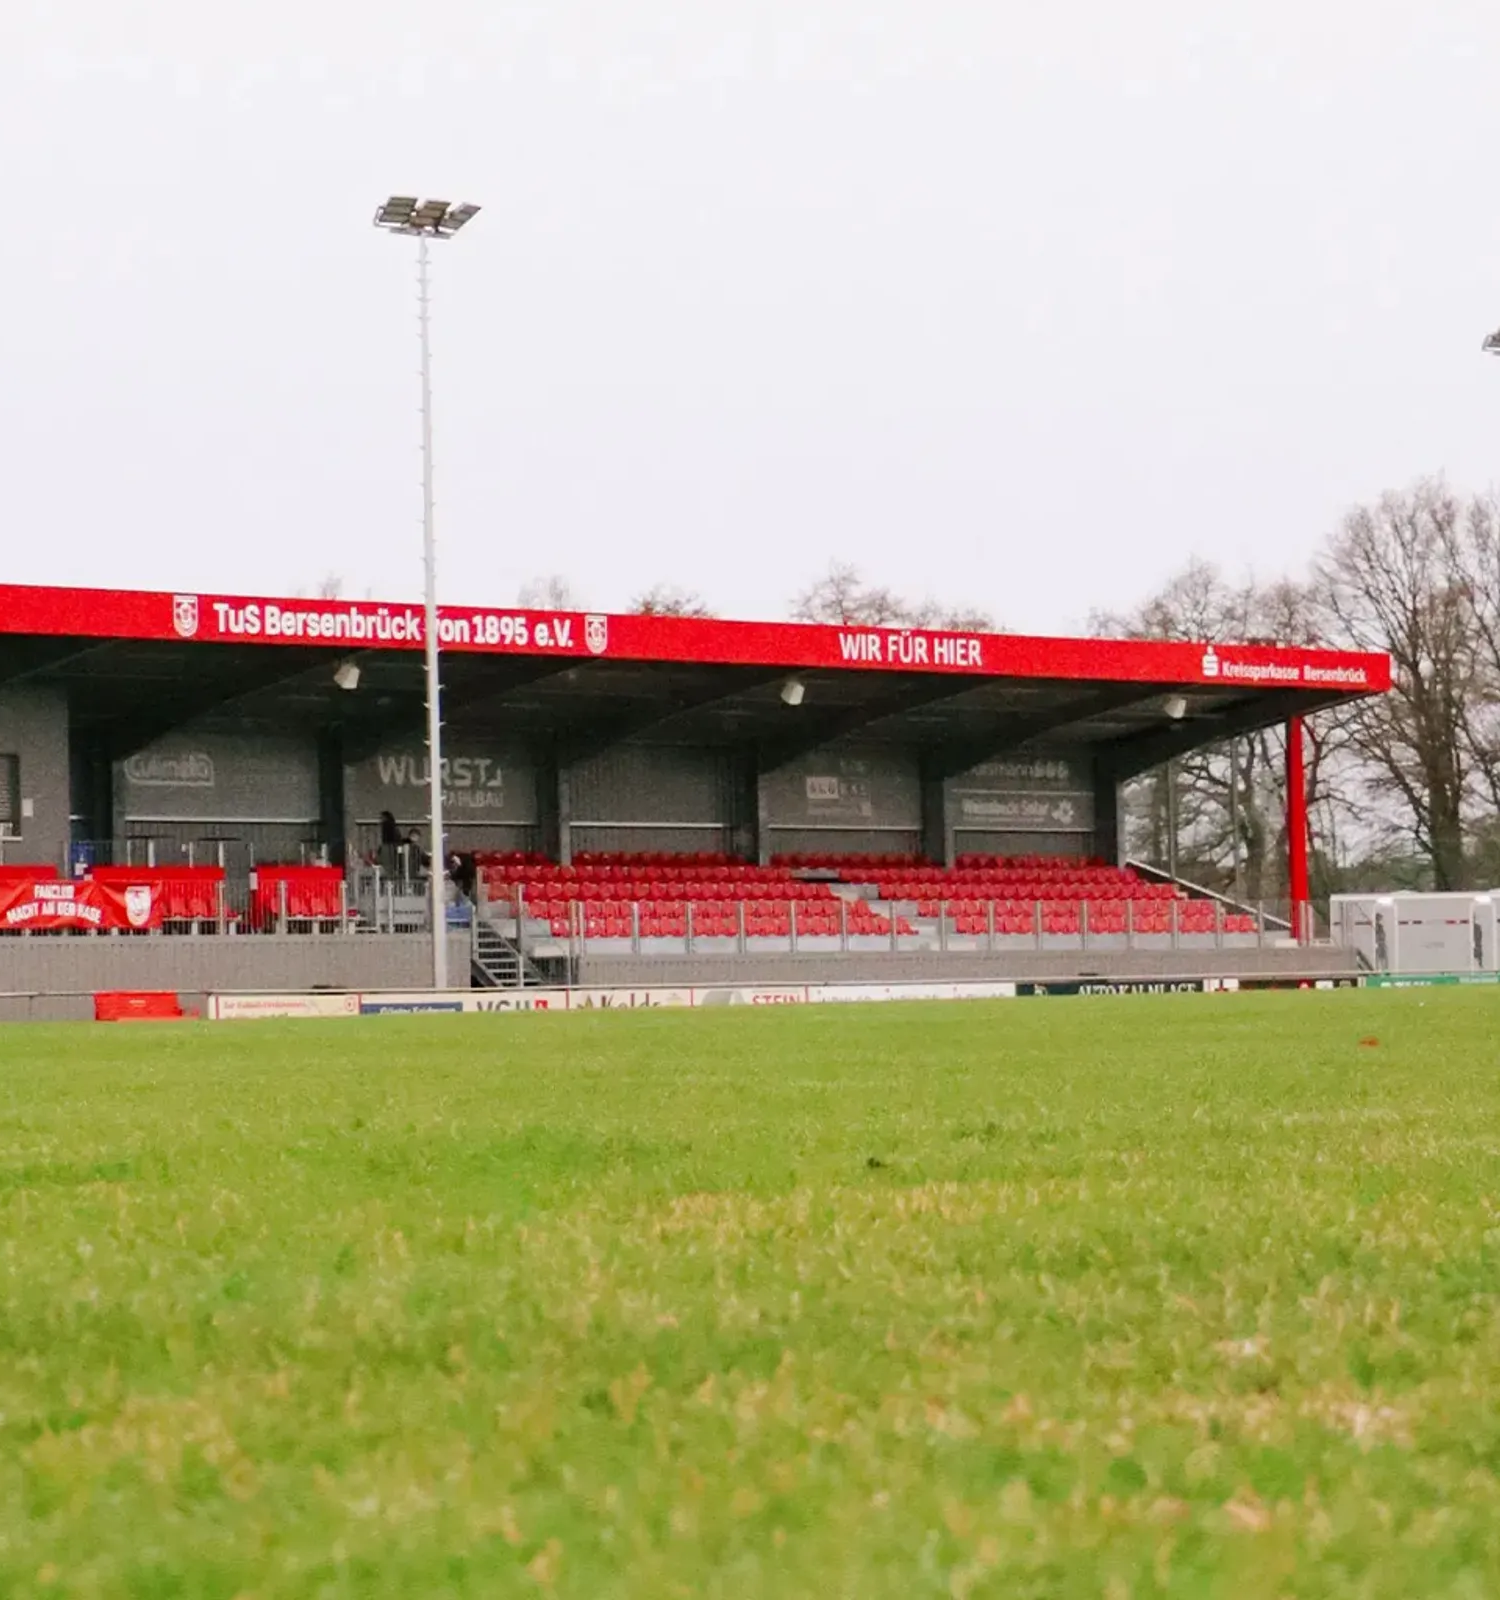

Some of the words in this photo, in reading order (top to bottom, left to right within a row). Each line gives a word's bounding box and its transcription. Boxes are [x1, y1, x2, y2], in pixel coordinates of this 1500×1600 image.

[213, 603, 260, 634] TuS
[264, 608, 422, 641] Bersenbrück
[433, 618, 470, 643] on
[472, 614, 528, 647] 1895
[534, 618, 574, 648] e.V.
[838, 632, 883, 662] WIR
[887, 630, 929, 664] FÜR
[933, 637, 983, 667] HIER
[1222, 661, 1300, 681] Kreissparkasse
[378, 755, 492, 786] WURST
